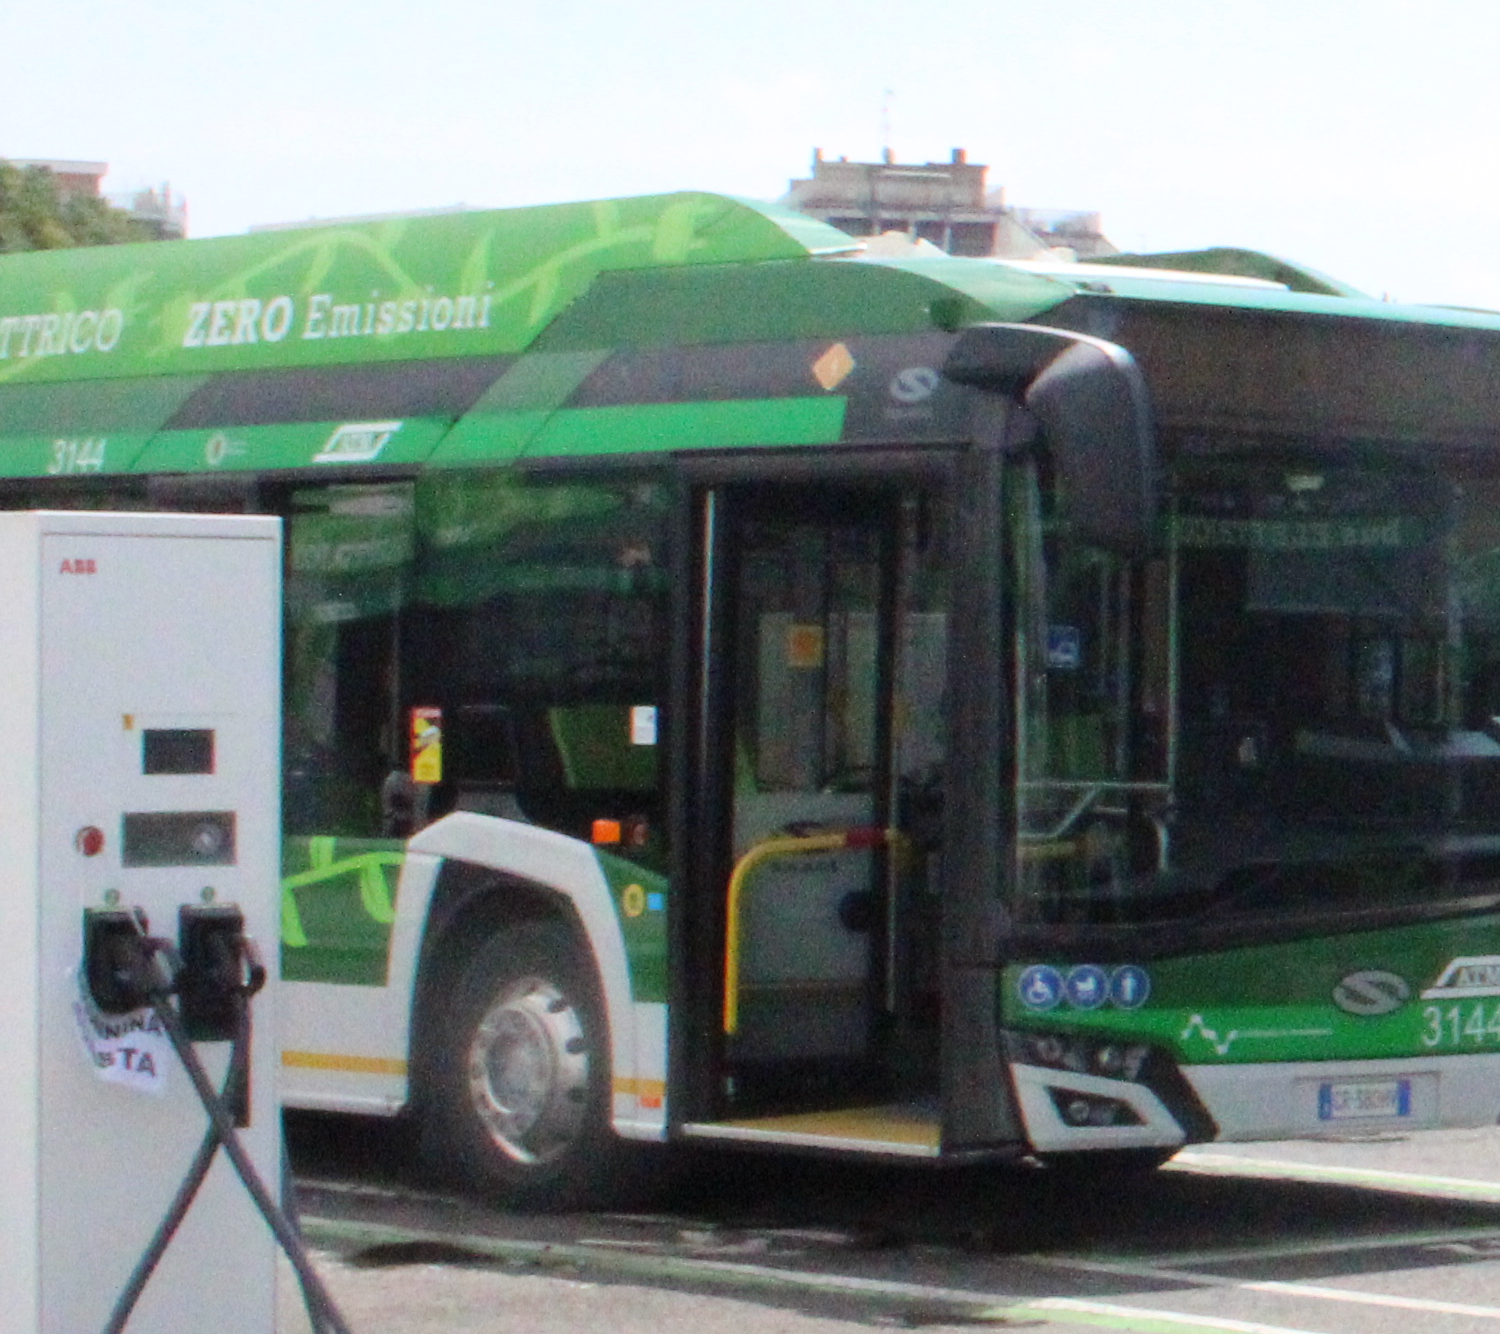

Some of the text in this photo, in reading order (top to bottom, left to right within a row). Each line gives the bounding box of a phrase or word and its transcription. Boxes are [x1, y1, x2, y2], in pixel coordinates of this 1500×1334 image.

[182, 295, 295, 348] ZERO
[302, 279, 497, 340] Emissioni
[60, 558, 98, 575] ABB
